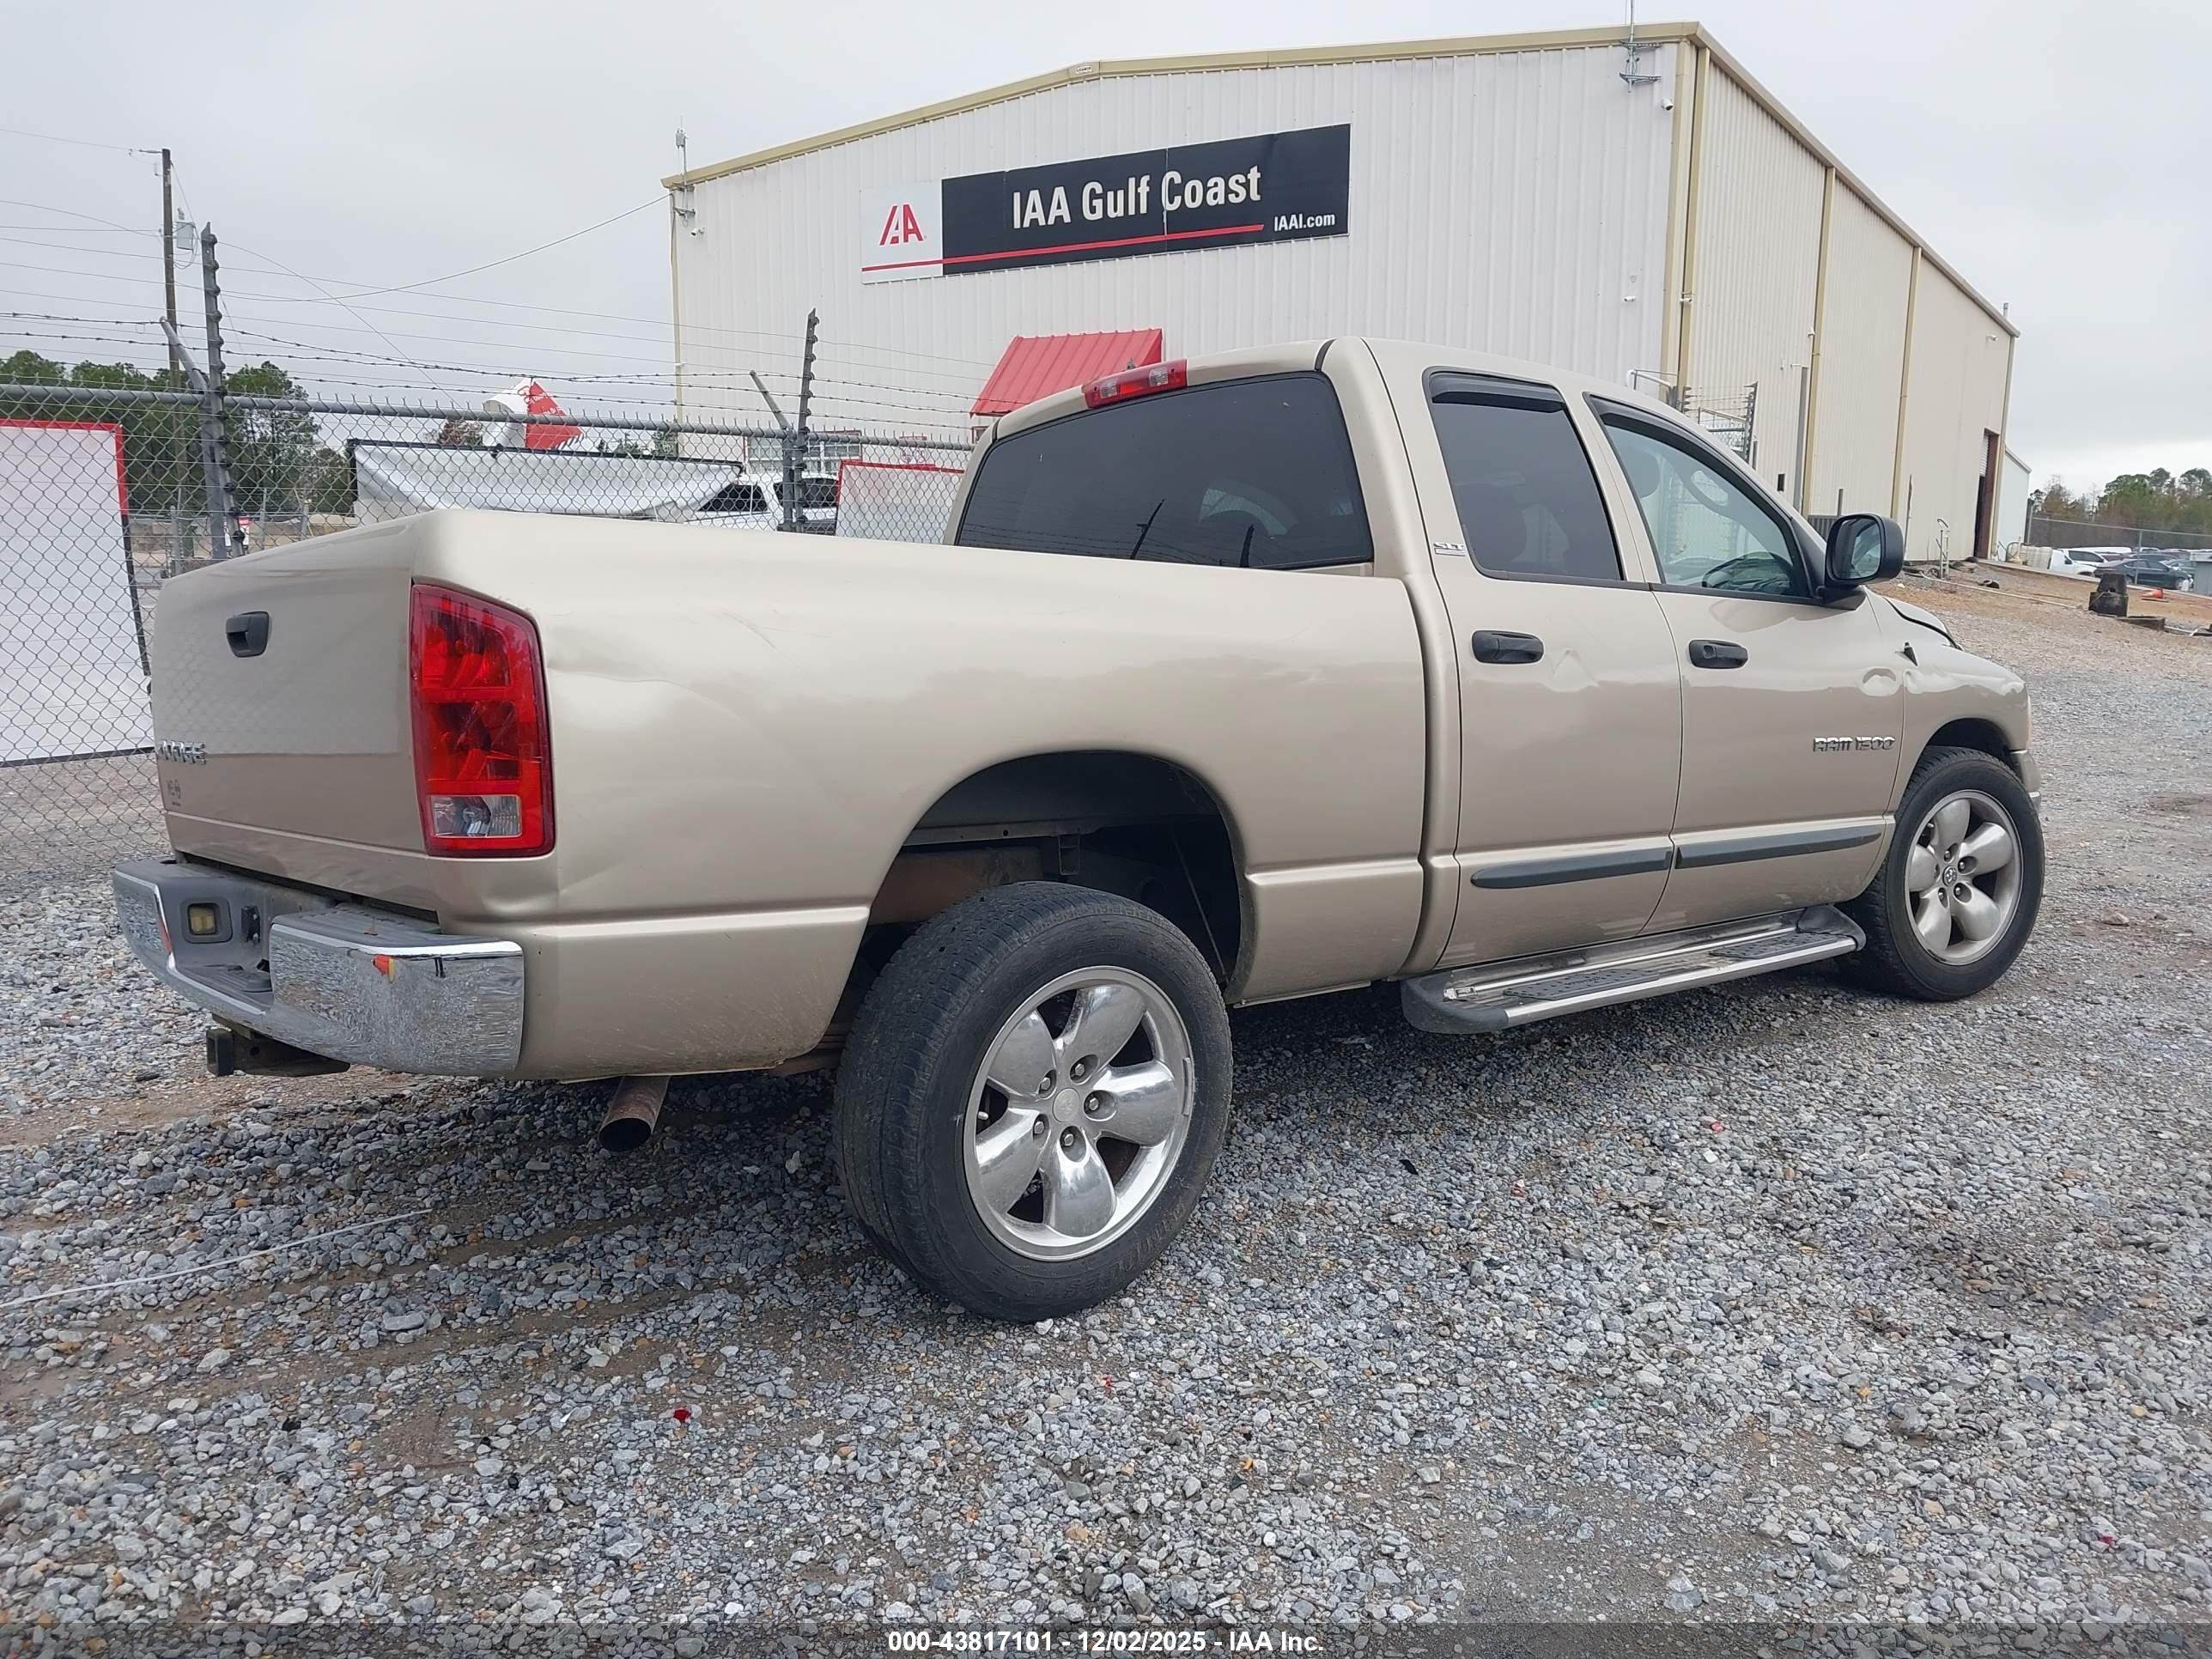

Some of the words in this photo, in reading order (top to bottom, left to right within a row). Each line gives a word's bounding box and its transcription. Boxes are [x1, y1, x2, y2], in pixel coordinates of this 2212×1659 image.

[1013, 185, 1072, 229] IAA
[1082, 174, 1151, 221] Gulf
[1161, 165, 1261, 211] Coast
[1273, 213, 1336, 232] IAAI.com
[1813, 736, 1853, 752] RAM
[1855, 735, 1896, 751] 1500
